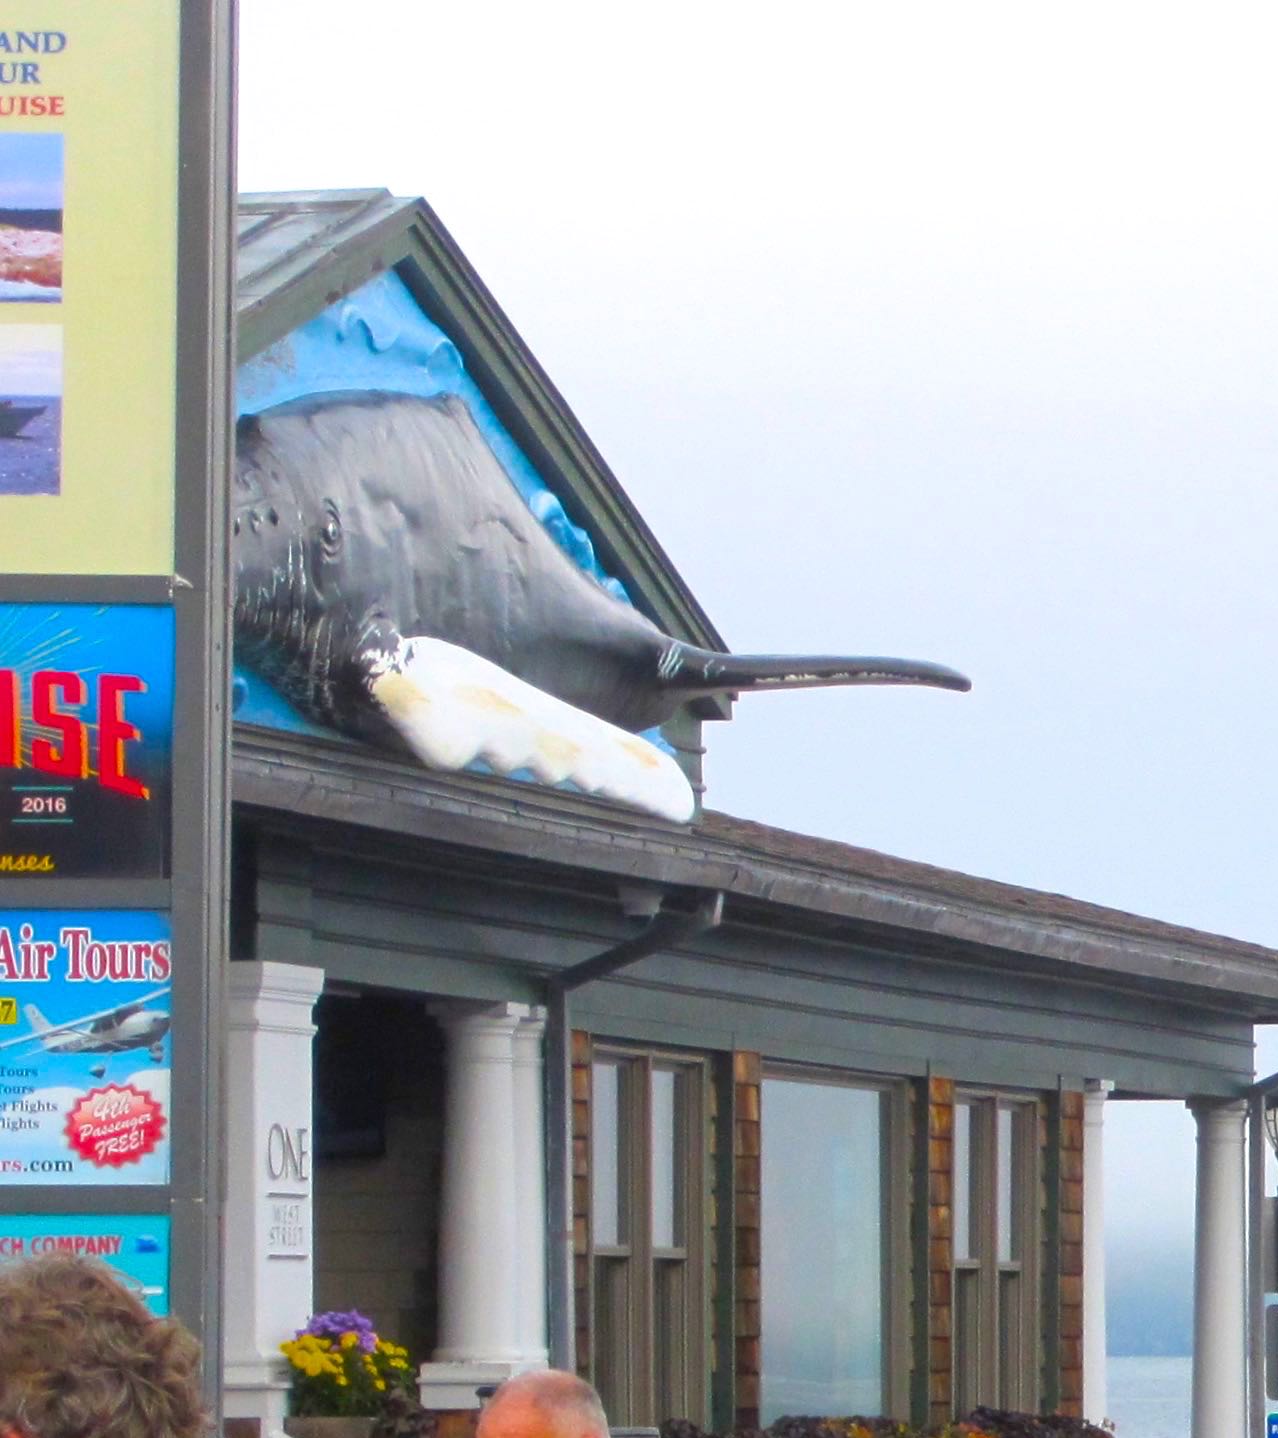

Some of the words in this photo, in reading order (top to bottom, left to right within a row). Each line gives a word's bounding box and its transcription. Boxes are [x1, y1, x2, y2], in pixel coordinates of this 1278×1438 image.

[21, 797, 67, 812] 2016
[0, 923, 57, 981] Air
[61, 928, 171, 981] Tours
[0, 1083, 34, 1094] ours
[12, 1100, 58, 1114] Flights
[93, 1096, 130, 1121] 4th
[0, 1117, 40, 1131] lights
[79, 1113, 151, 1142] Passenger
[94, 1129, 145, 1160] FREE!
[268, 1123, 308, 1181] ONE
[31, 1236, 121, 1255] COMPANY
